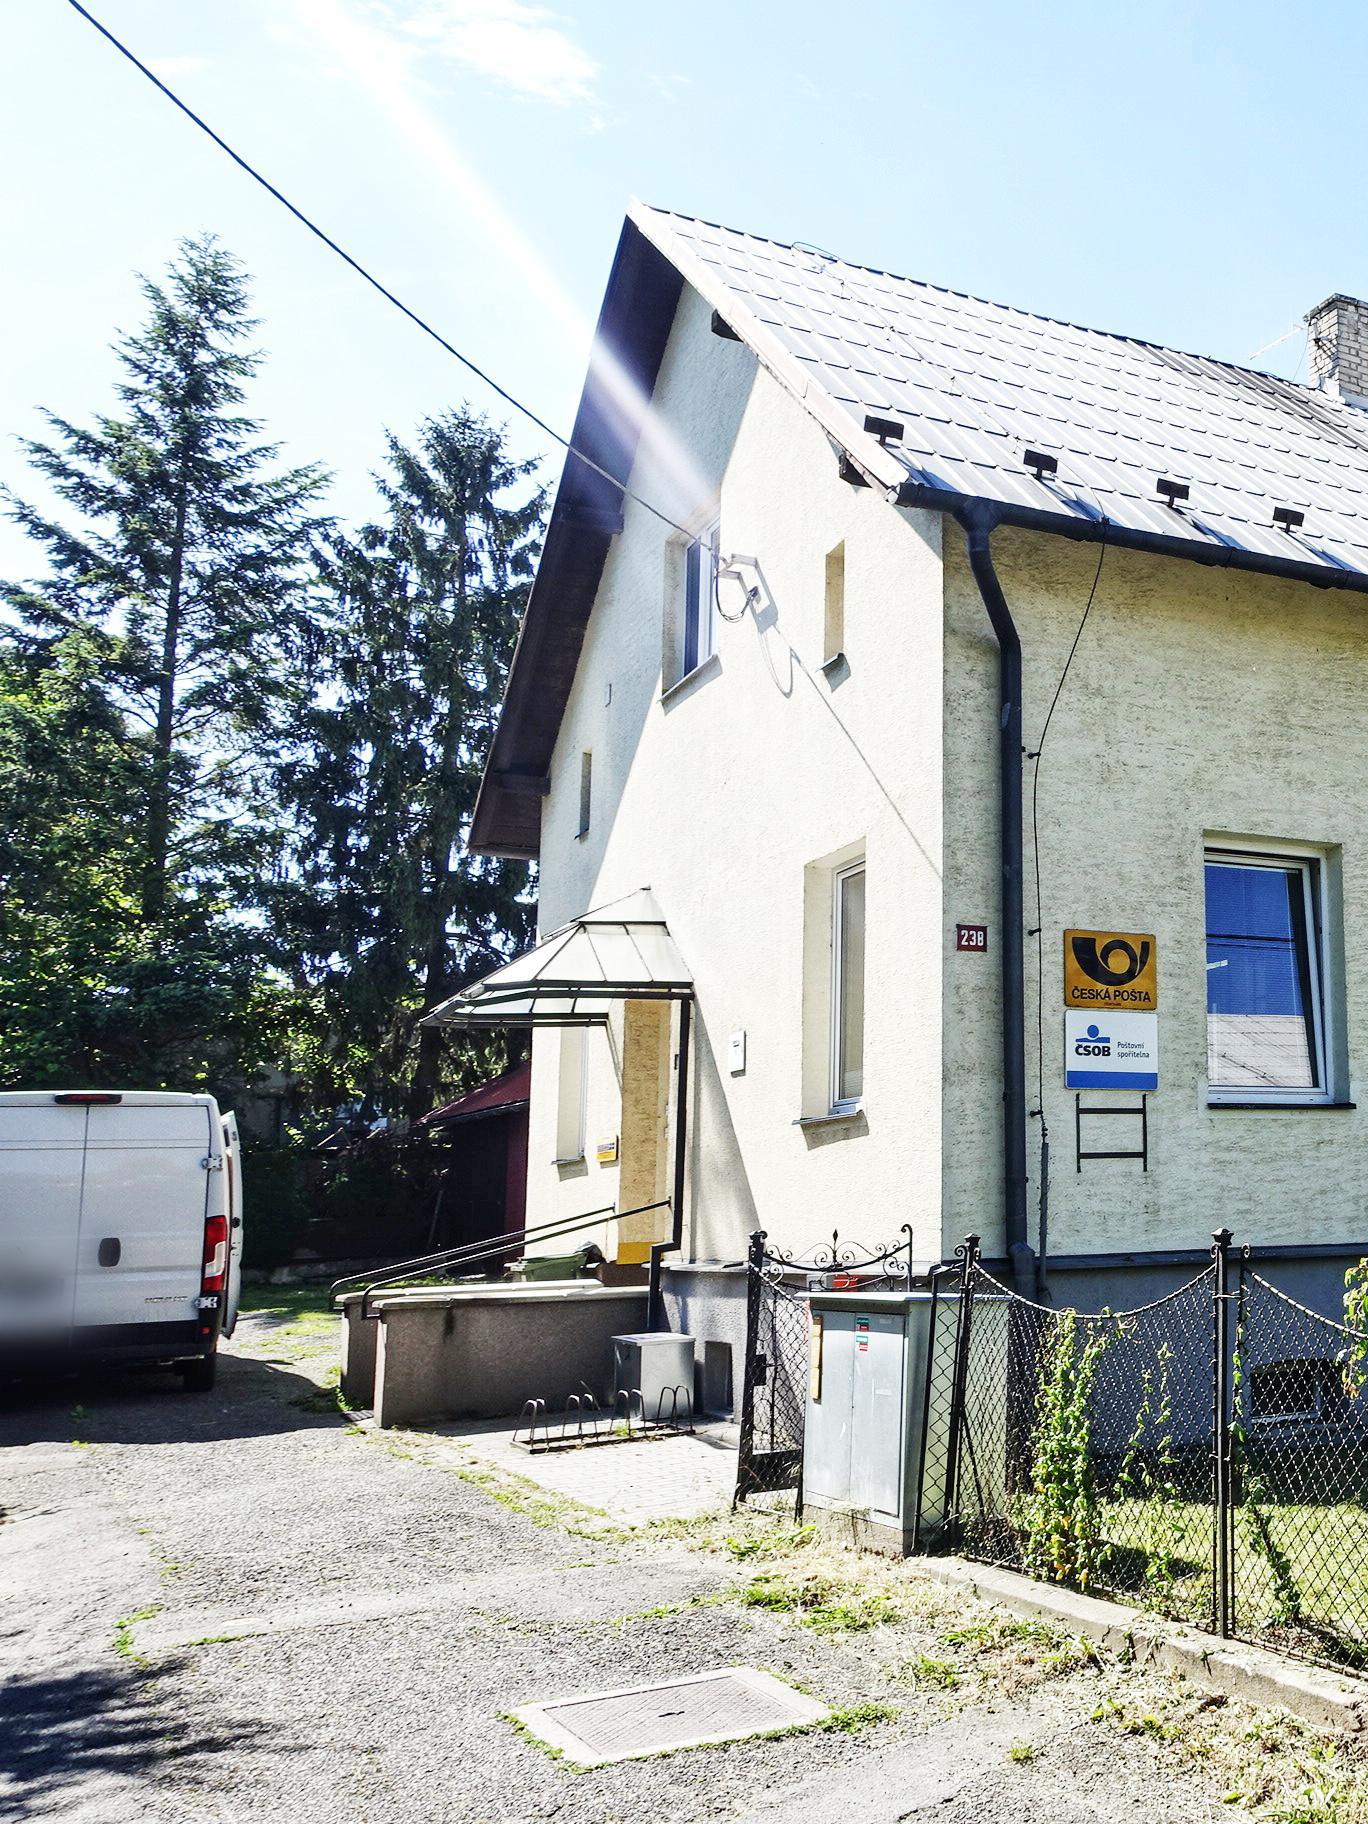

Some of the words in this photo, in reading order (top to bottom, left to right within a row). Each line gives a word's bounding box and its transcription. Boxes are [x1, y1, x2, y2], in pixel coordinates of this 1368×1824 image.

[961, 930, 984, 946] 238
[1072, 986, 1111, 1000] ČESKÁ
[1113, 989, 1151, 1002] POŠTA
[1075, 1043, 1111, 1056] ČSOB
[1117, 1041, 1144, 1049] Poštovní
